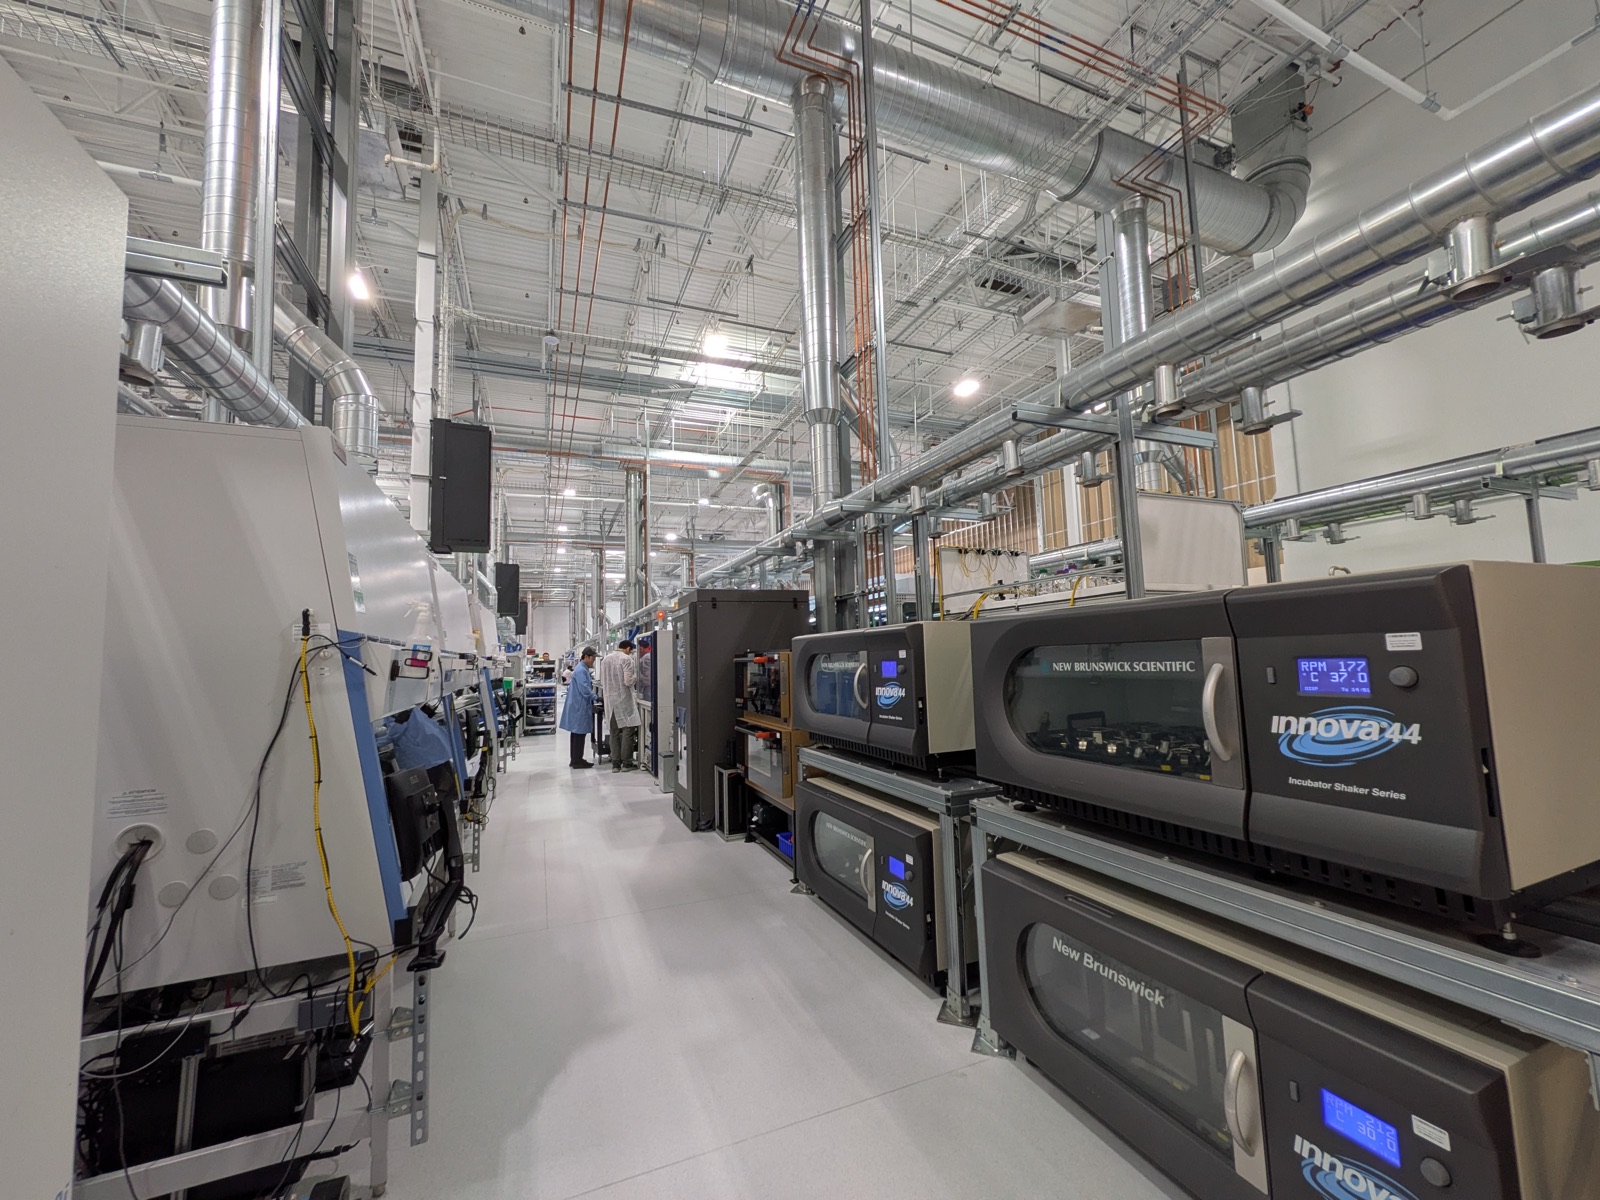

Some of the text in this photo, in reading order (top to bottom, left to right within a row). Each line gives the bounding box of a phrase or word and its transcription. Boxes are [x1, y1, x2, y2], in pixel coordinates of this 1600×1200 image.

[1052, 660, 1196, 672] NEW BRUNSWICK SCIENTIFIC
[1300, 661, 1366, 672] RPM 177
[1329, 672, 1368, 683] 37.0
[1288, 776, 1407, 800] Incubator Shaker Series
[1052, 936, 1165, 1008] New Brunswick
[1326, 1092, 1353, 1117] RPM
[1365, 1114, 1396, 1140] 212
[1356, 1120, 1396, 1153] 30.0
[1293, 1134, 1402, 1200] innov
